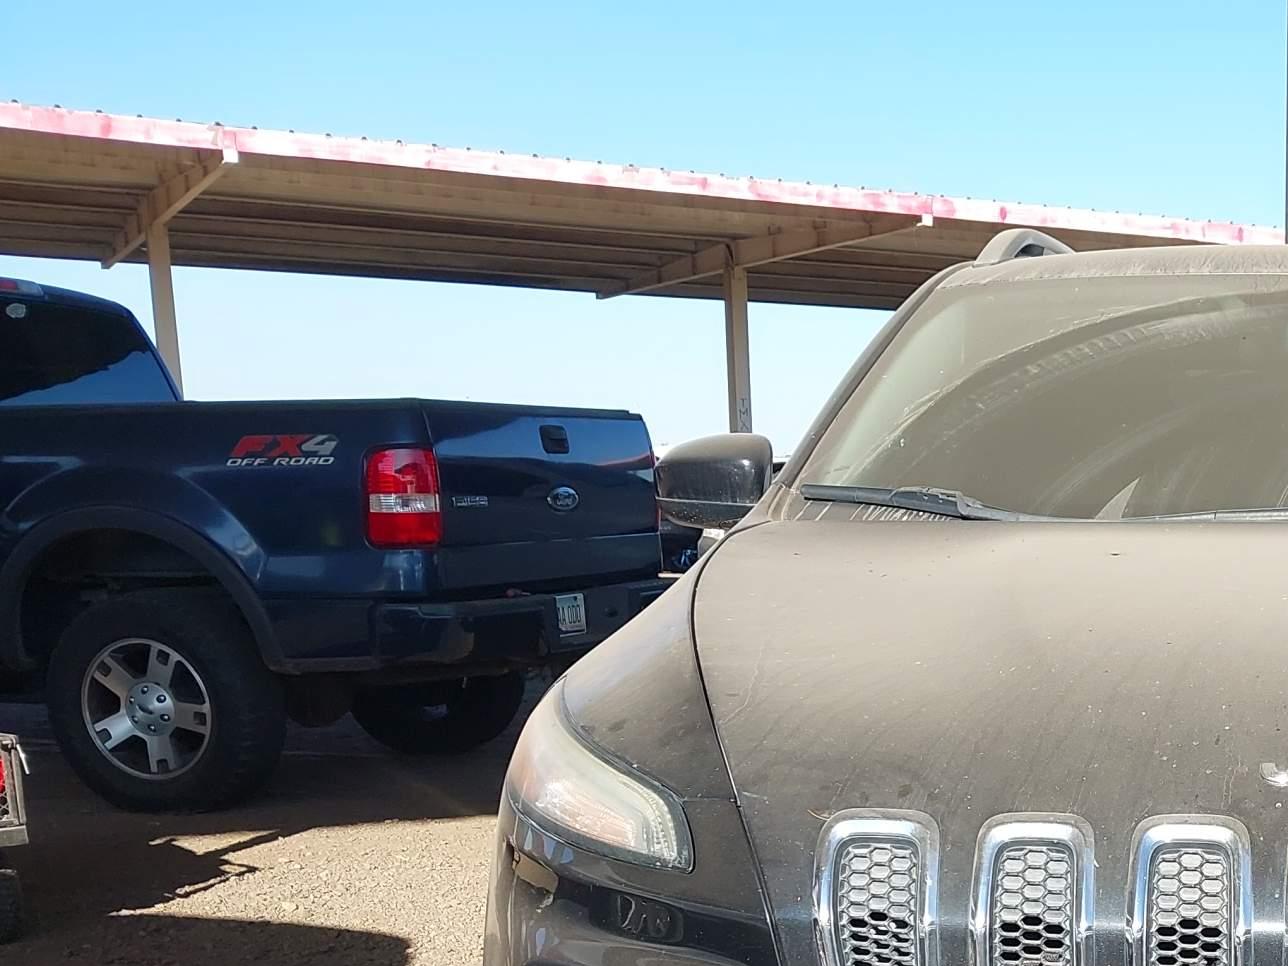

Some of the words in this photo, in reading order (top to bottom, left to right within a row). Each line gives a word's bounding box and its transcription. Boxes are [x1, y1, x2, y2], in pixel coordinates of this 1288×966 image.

[231, 434, 338, 457] FX4
[226, 458, 268, 467] OFF
[273, 456, 335, 466] ROAD
